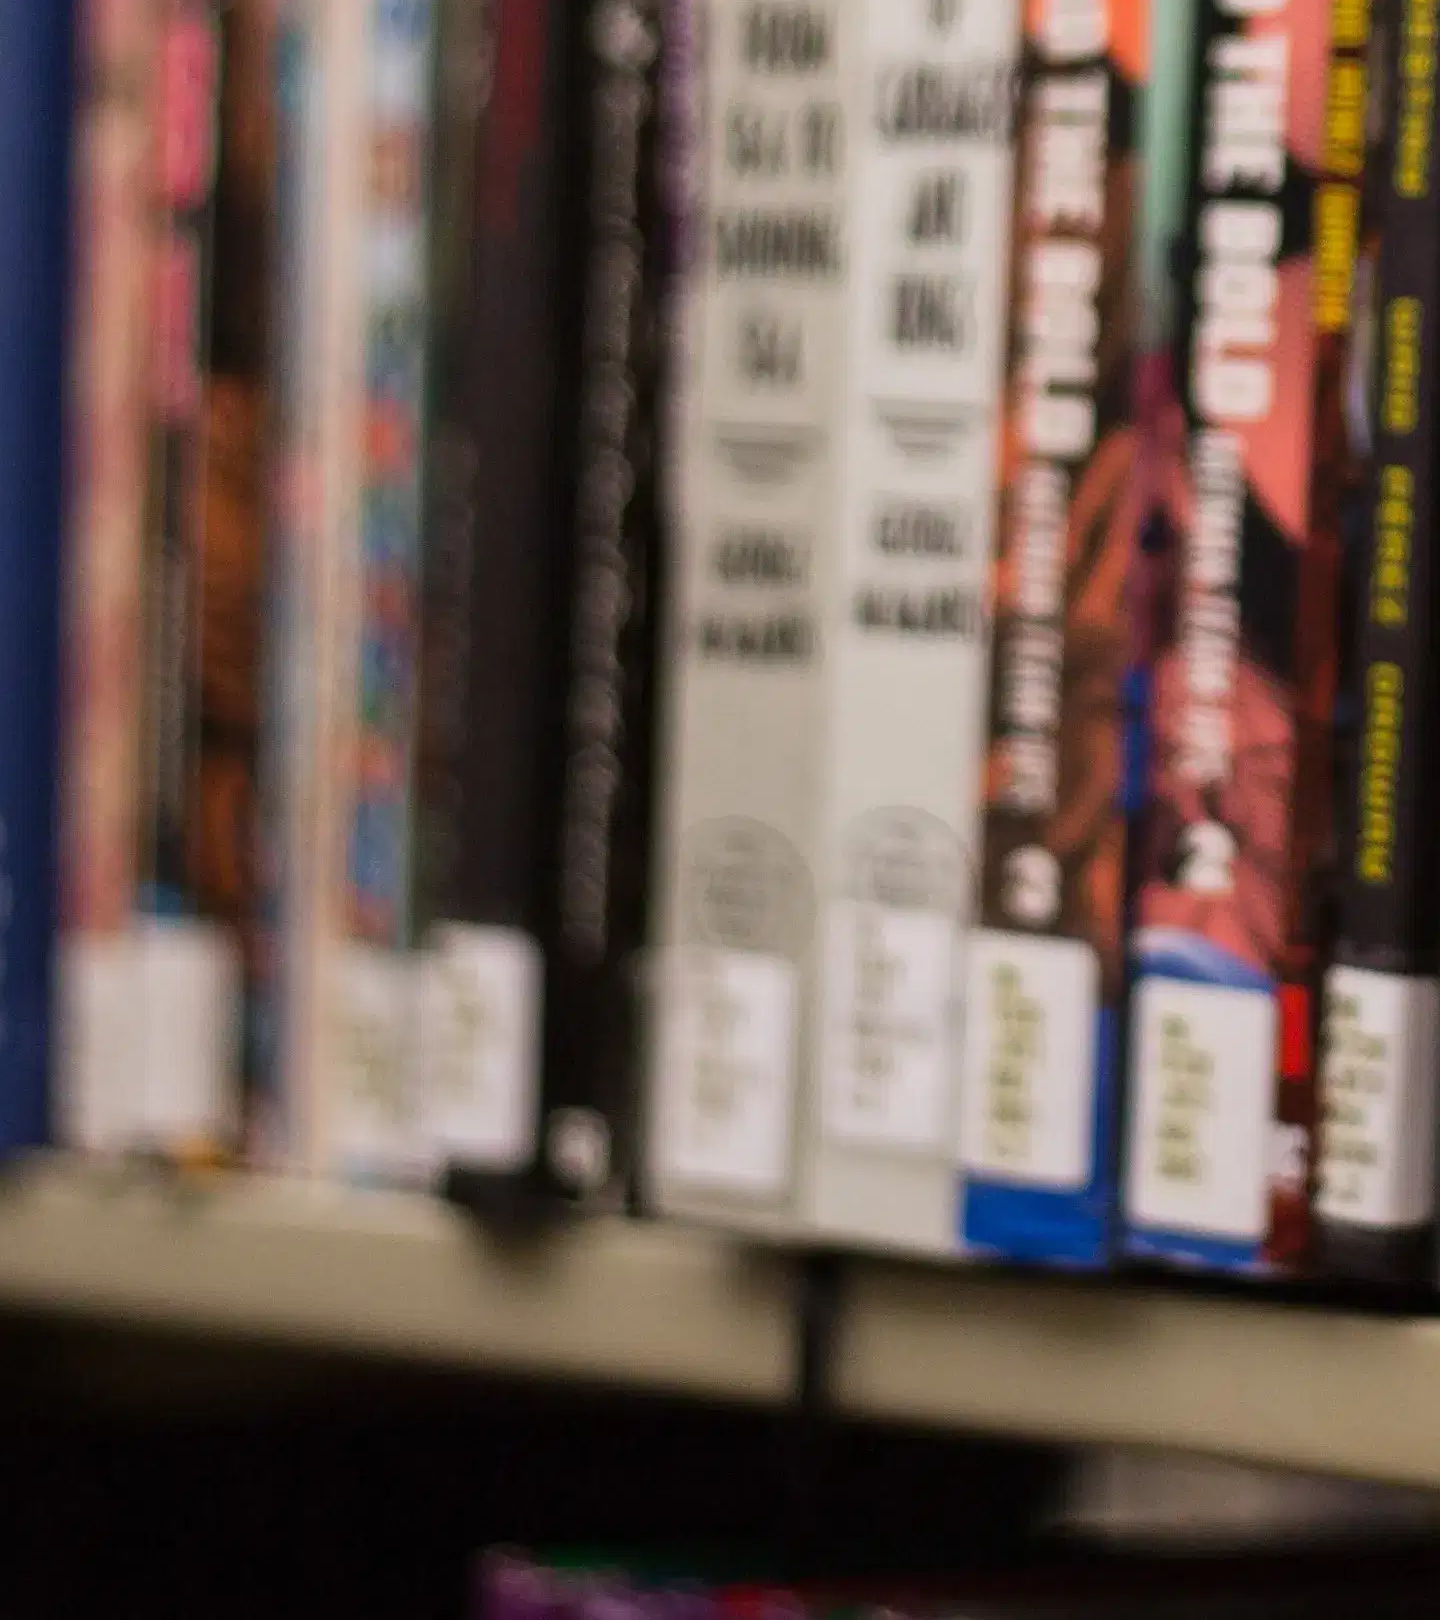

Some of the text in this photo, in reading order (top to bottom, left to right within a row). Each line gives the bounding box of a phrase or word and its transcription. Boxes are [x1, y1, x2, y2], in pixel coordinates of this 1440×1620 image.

[1031, 77, 1111, 231] THE
[1198, 31, 1289, 195] THE
[1022, 238, 1106, 459] BOLD
[1187, 198, 1283, 424] BOLD
